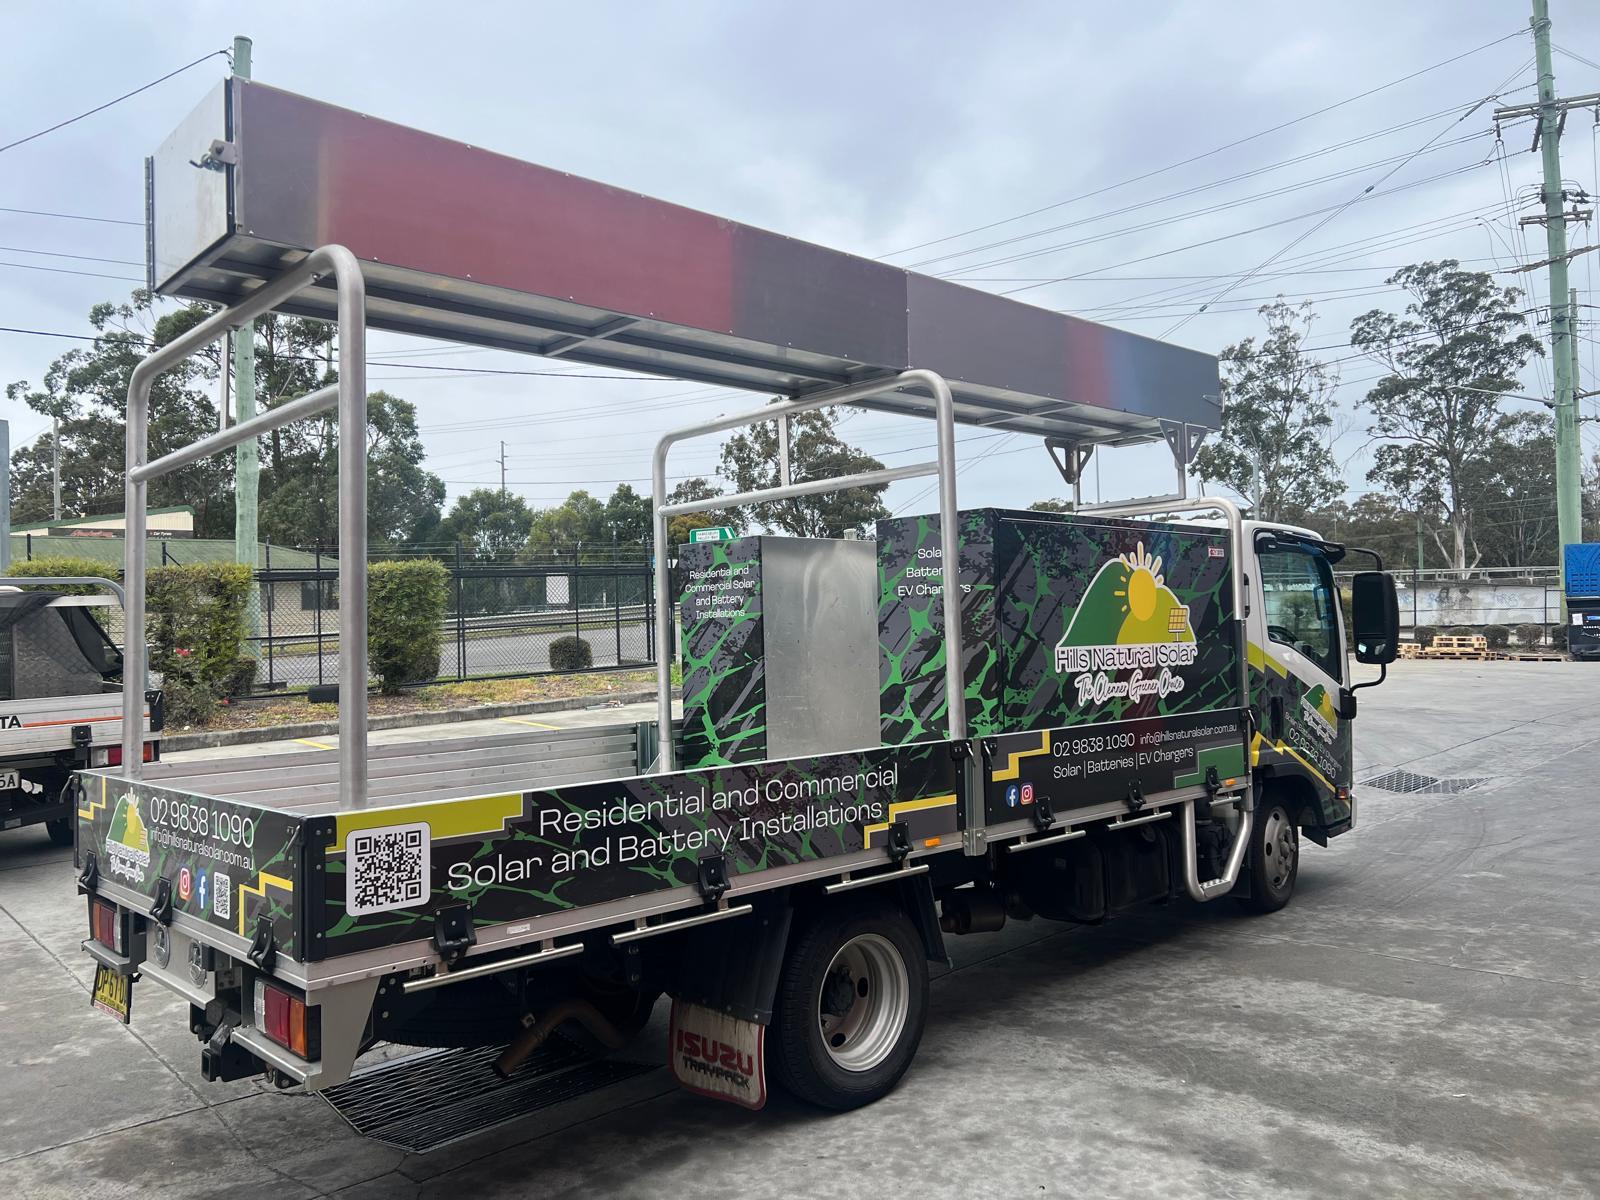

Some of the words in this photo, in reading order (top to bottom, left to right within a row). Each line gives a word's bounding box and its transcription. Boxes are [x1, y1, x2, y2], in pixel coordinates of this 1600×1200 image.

[917, 547, 943, 559] Sola
[685, 581, 732, 593] Commercial
[733, 579, 755, 589] Solar
[689, 568, 732, 579] Residential
[734, 565, 749, 575] and
[696, 596, 710, 606] and
[712, 595, 744, 606] Battery
[897, 585, 914, 596] EV
[696, 609, 745, 619] Installations
[1056, 648, 1089, 669] Hills
[1093, 645, 1156, 667] Natural
[1158, 644, 1197, 664] Solar
[1076, 674, 1093, 705] The
[1129, 670, 1158, 702] Greener
[1159, 668, 1184, 698] Choice
[1053, 741, 1070, 757] 02
[1072, 737, 1104, 755] 9838
[1105, 733, 1135, 750] 1090
[1140, 724, 1237, 745] info@hillsnaturalsolar.com.au
[1053, 763, 1081, 779] Solar
[1087, 756, 1134, 774] Batteries
[1139, 752, 1152, 765] EV
[1154, 747, 1194, 763] Chargers
[539, 787, 705, 836] Residential
[712, 779, 759, 811] and
[765, 763, 898, 802] Commercial
[150, 796, 168, 826] 02
[170, 801, 209, 836] 9838
[212, 810, 254, 848] 1090
[447, 854, 543, 892] Solar
[551, 837, 610, 874] and
[619, 823, 733, 863] Battery
[739, 801, 883, 841] Installations
[677, 1029, 753, 1077] ISUZU
[683, 1055, 751, 1090] TRAYPACK
